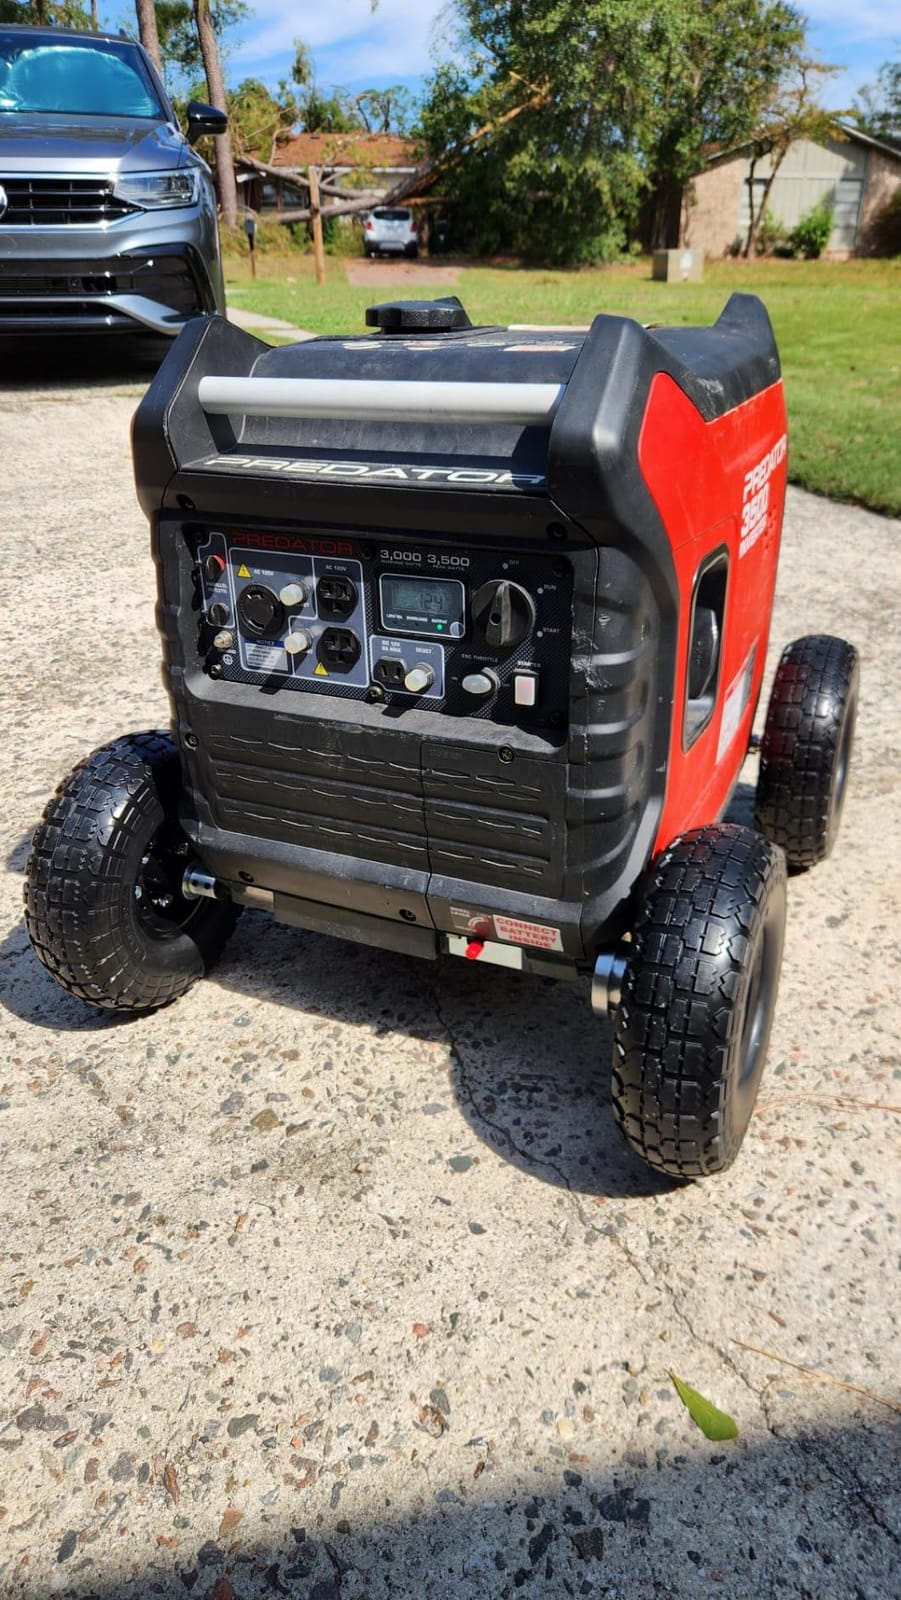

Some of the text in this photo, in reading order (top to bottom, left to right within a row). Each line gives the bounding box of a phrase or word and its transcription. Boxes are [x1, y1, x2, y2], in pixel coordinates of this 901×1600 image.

[204, 456, 546, 485] PREDATOR
[231, 531, 353, 554] PREDATOR
[380, 549, 470, 566] 3,000 3,500
[496, 917, 558, 936] CONNECT
[500, 926, 557, 943] BATTERY
[508, 935, 552, 947] INSIDE
